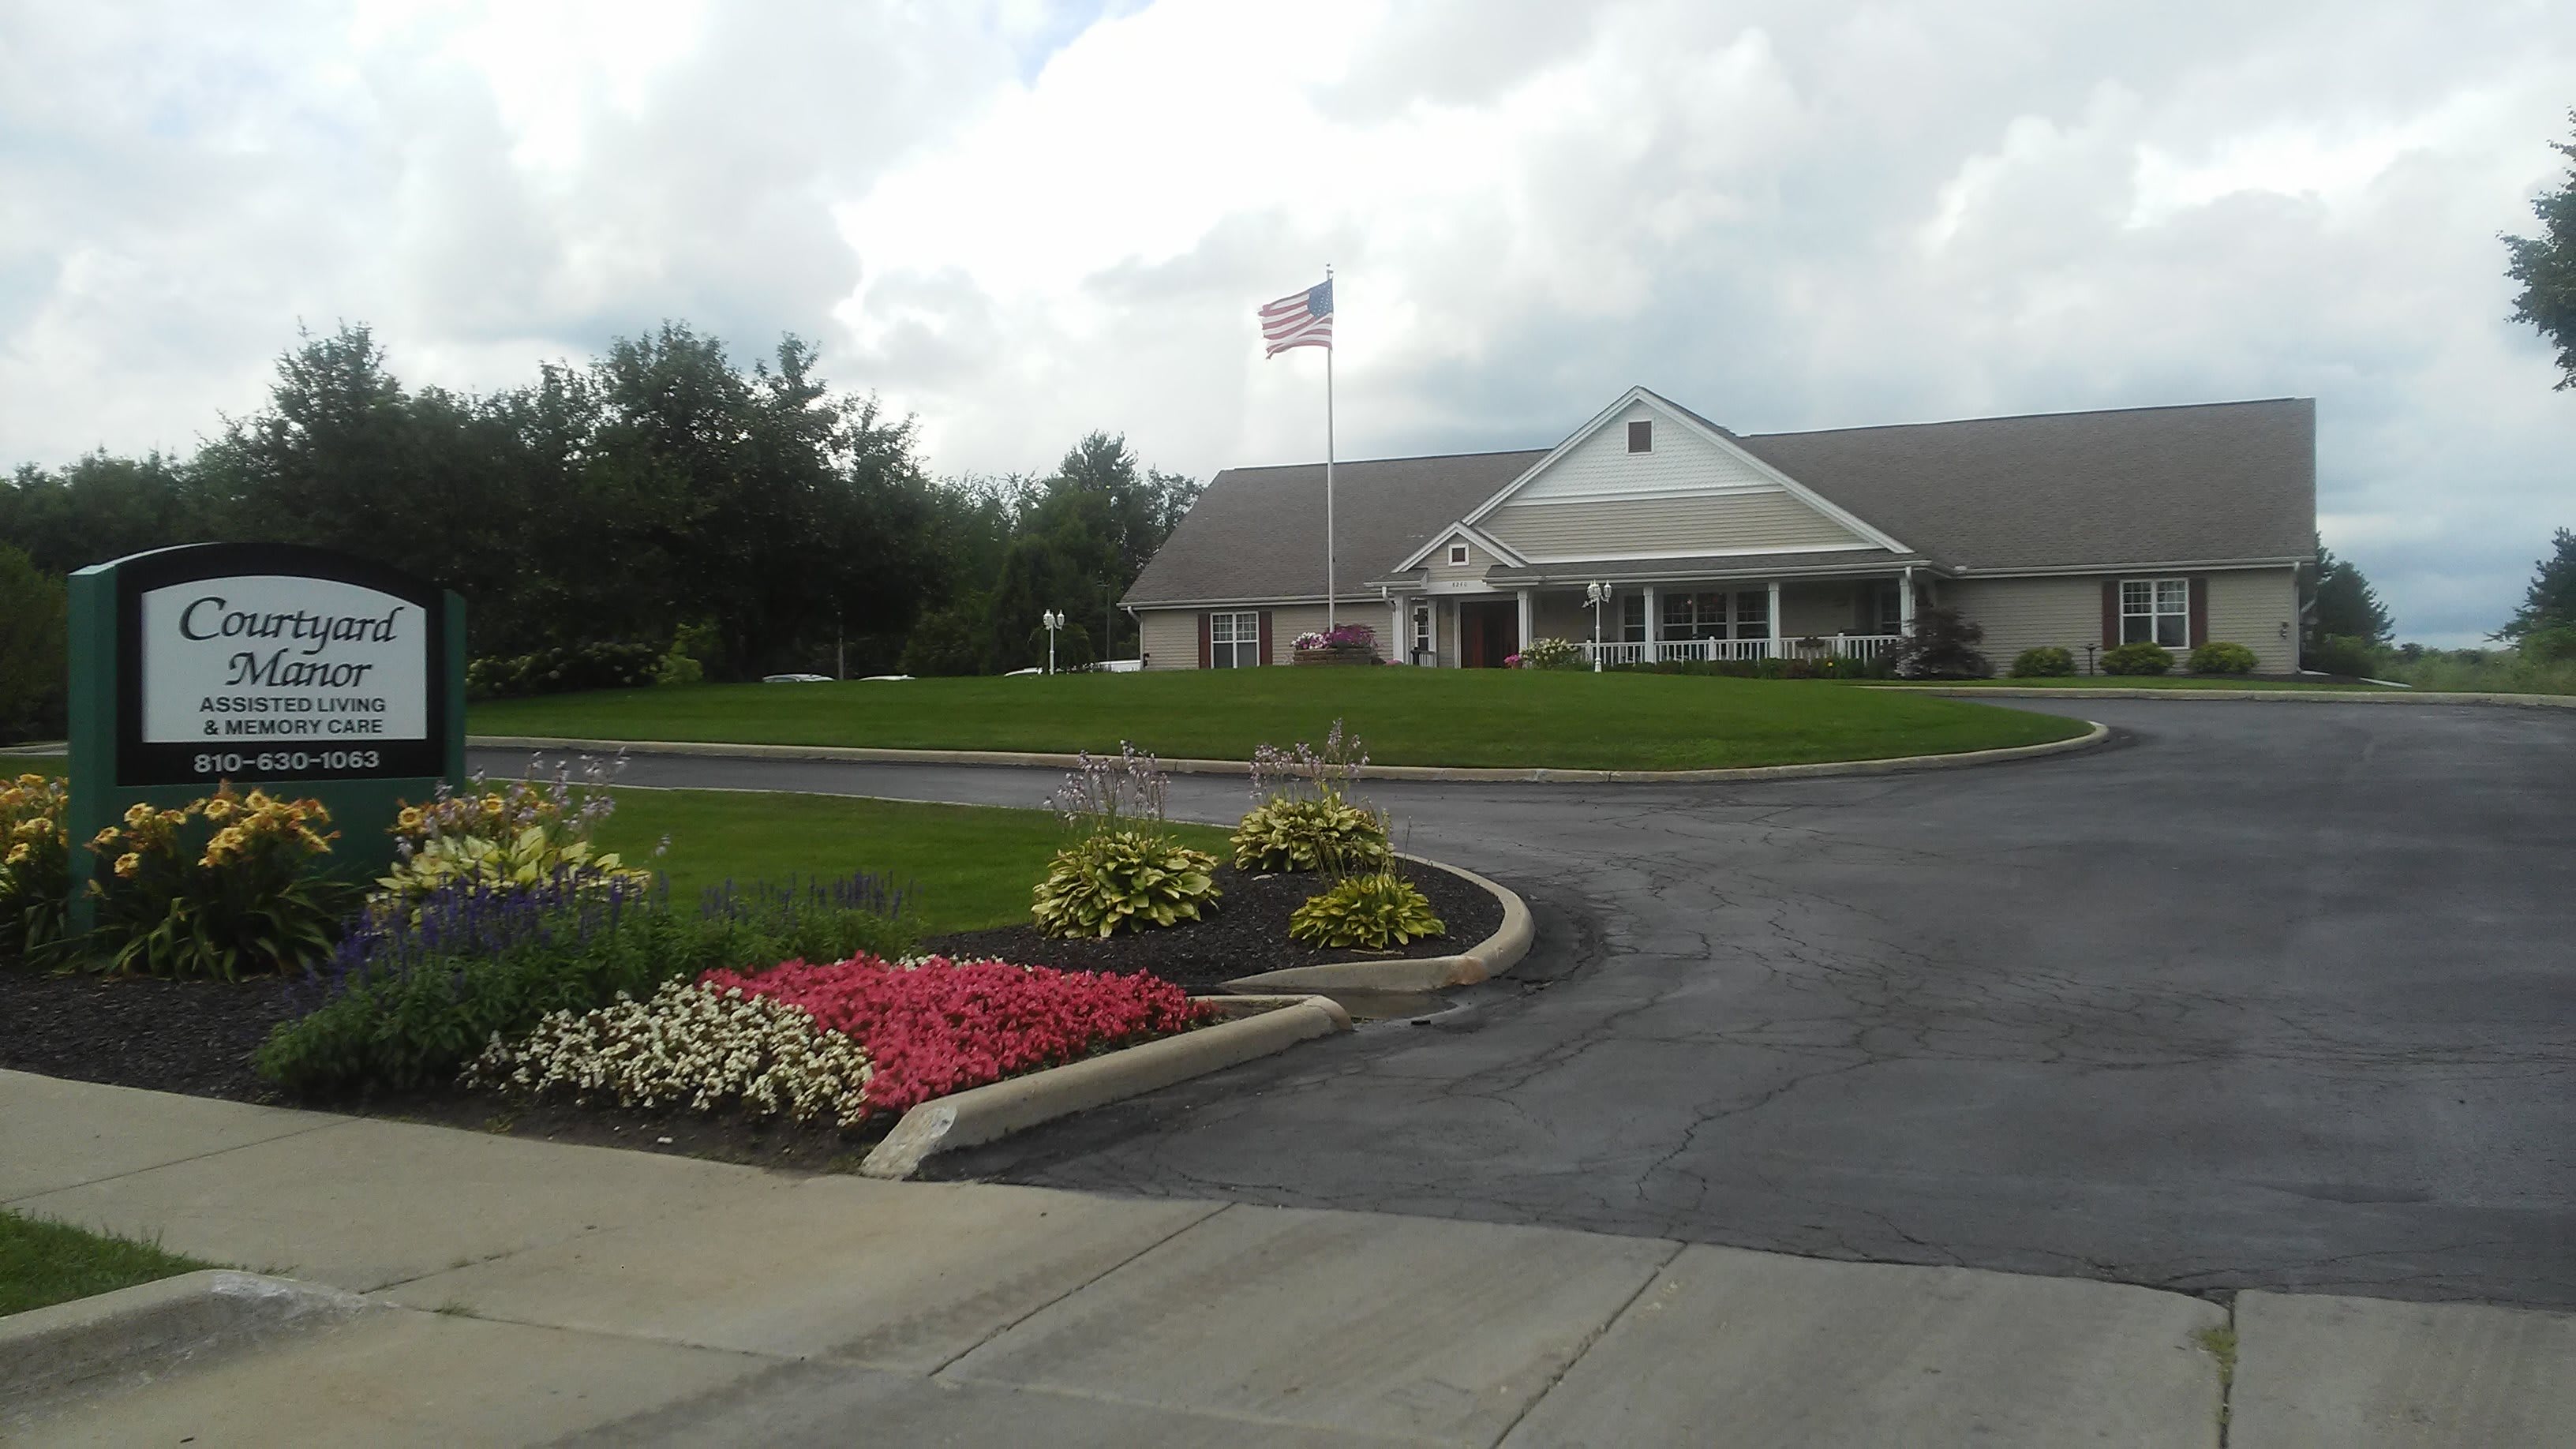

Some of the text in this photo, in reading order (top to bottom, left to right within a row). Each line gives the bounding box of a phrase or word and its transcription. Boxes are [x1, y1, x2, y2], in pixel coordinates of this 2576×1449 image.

[179, 597, 404, 655] Courtyard
[225, 648, 373, 689] Manor
[199, 697, 386, 712] ASSISTED LIVING
[203, 719, 384, 735] & MEMORY CARE
[193, 751, 380, 773] 810-630-1063
